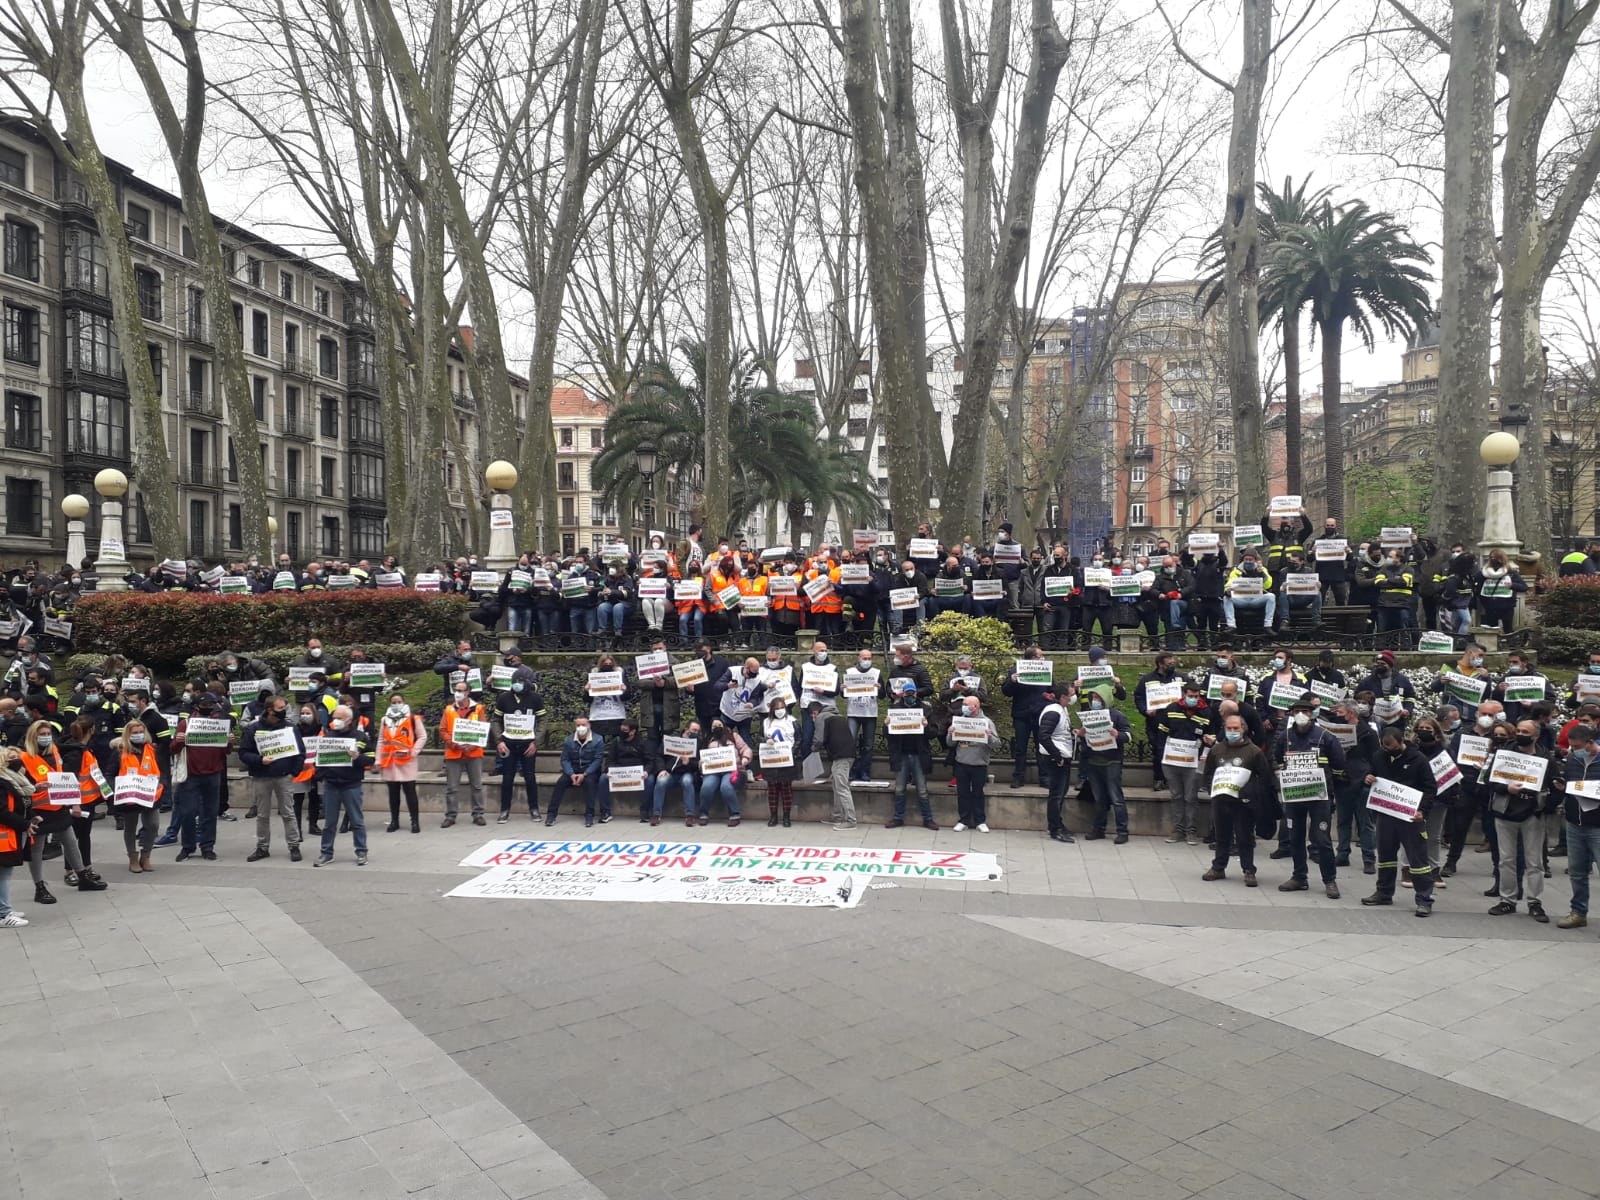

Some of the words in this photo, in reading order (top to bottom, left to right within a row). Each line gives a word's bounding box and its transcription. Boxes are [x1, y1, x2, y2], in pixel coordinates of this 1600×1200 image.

[483, 853, 697, 867] READMISION
[709, 857, 763, 869] HAY
[767, 860, 968, 877] ALTERNATIVAS
[504, 841, 702, 856] AERNNOVA
[891, 851, 967, 867] EZ
